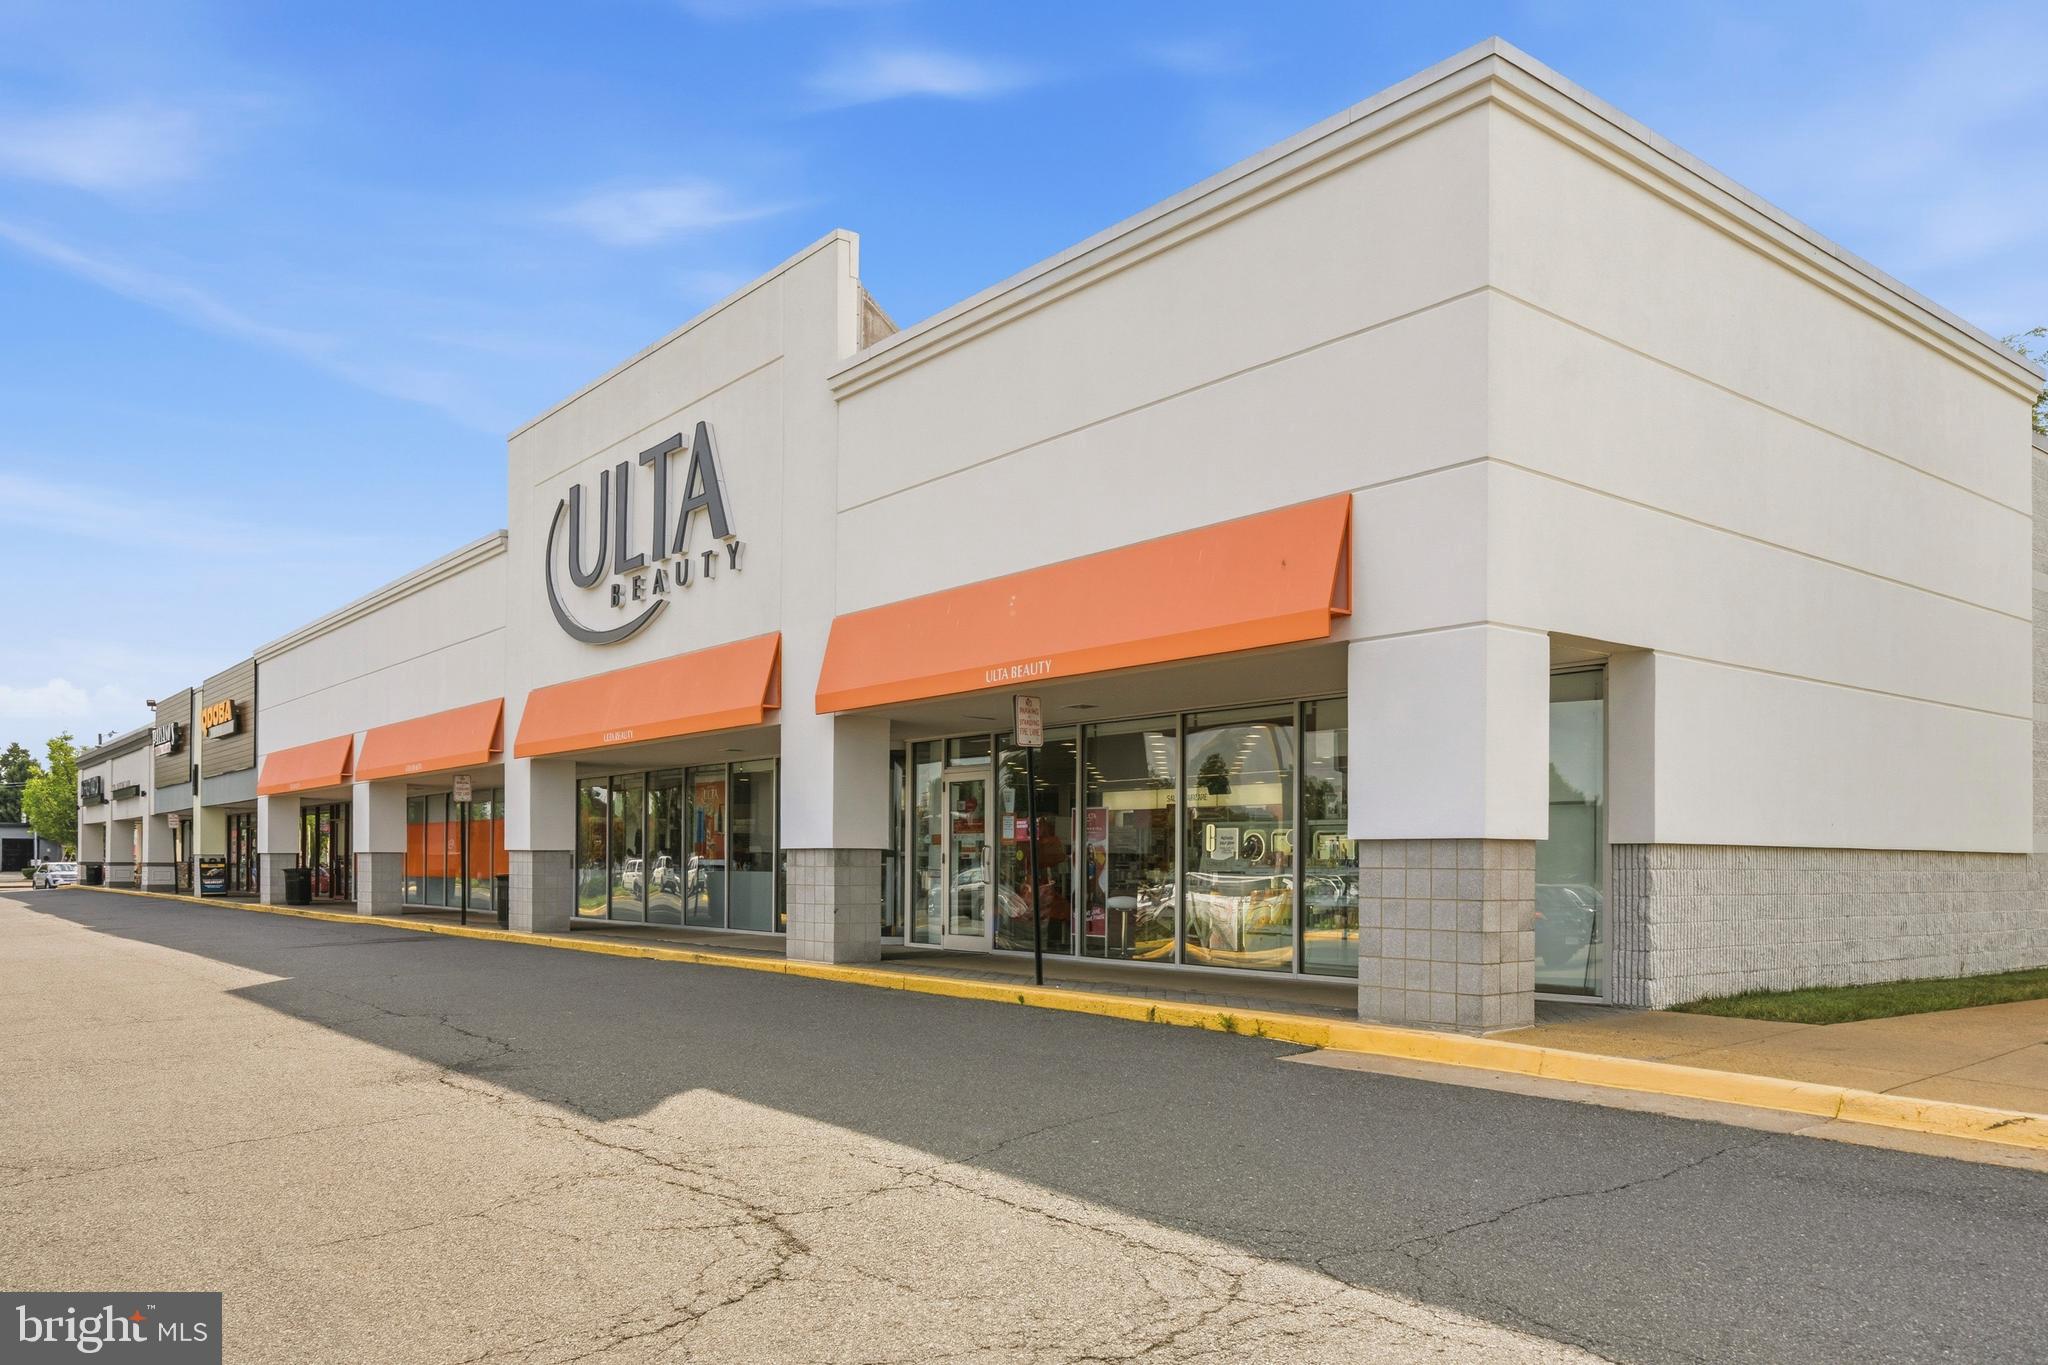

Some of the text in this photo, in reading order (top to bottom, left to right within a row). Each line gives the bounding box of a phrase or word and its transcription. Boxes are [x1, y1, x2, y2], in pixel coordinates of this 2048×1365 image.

[568, 420, 736, 590] ULTA
[611, 540, 746, 609] BEAUTY
[985, 659, 1052, 683] ULTA BEAUTY
[201, 698, 233, 738] QDOBA
